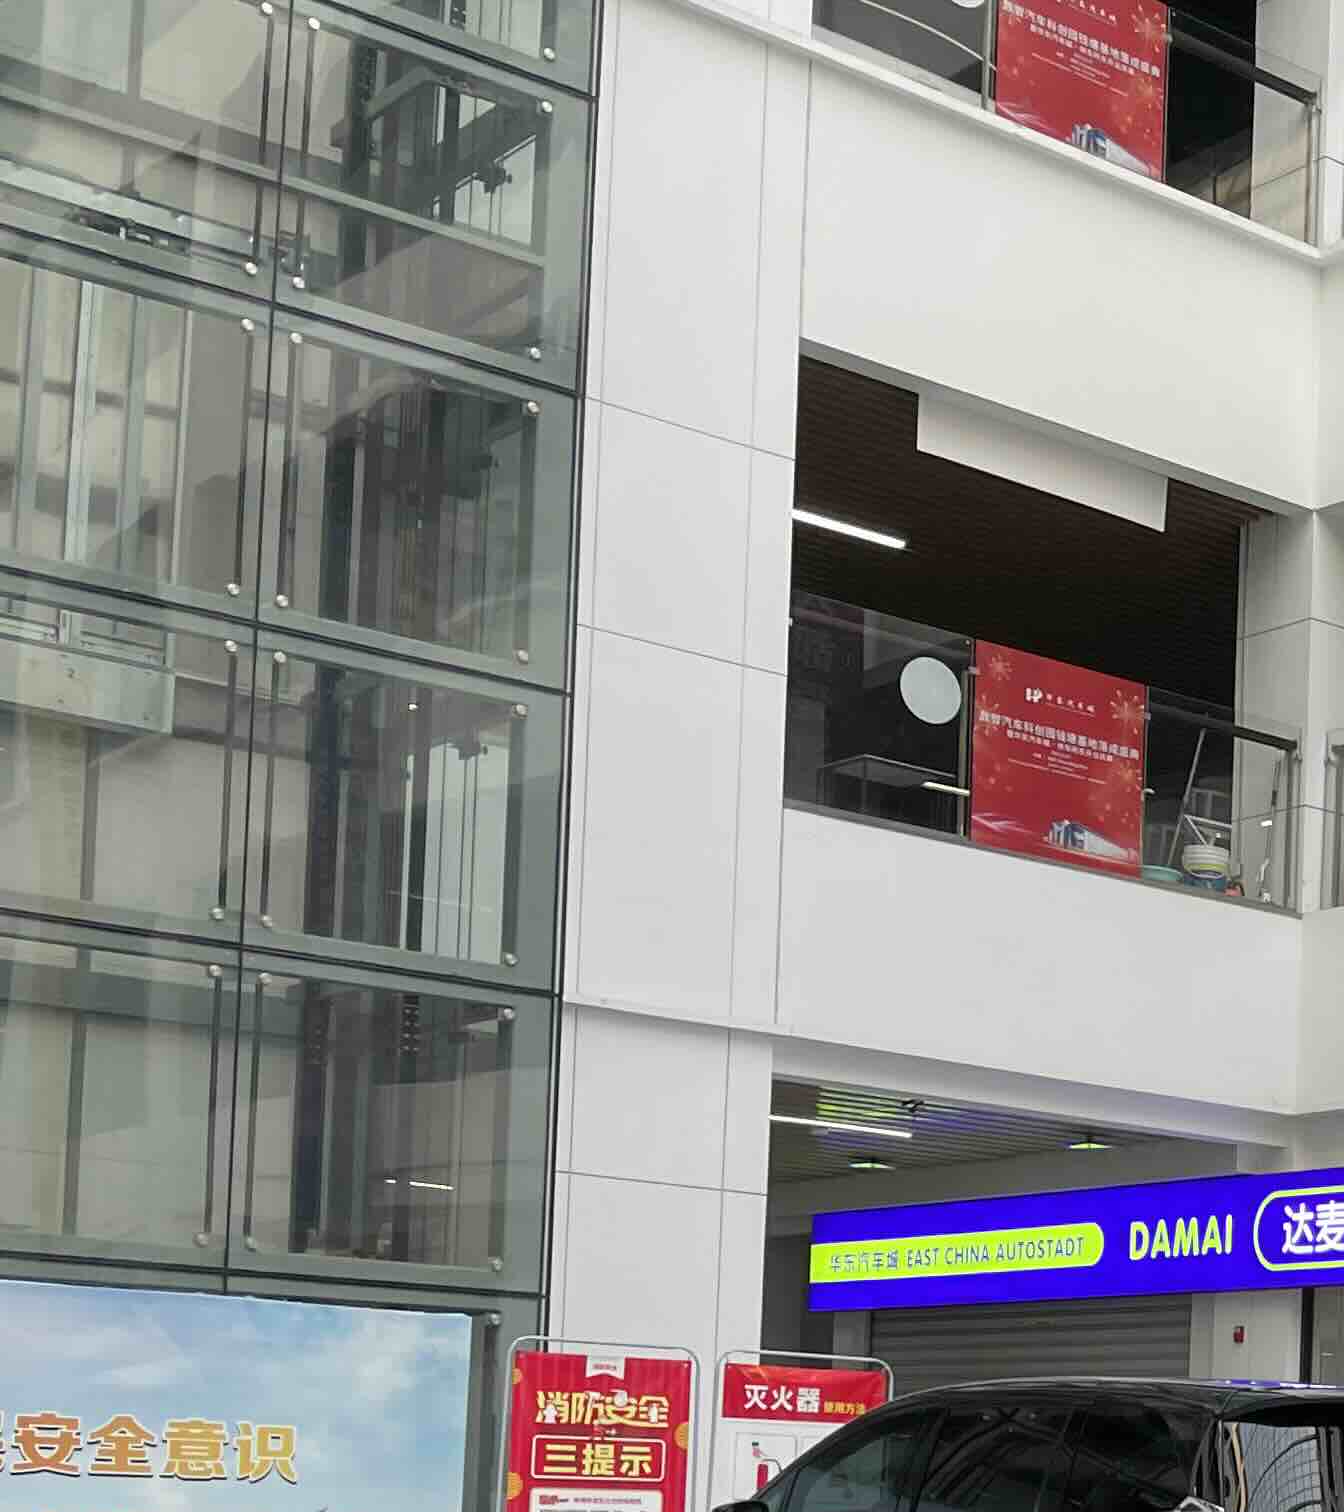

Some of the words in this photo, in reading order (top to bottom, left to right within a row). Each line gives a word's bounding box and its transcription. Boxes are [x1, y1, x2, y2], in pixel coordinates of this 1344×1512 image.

[830, 1251, 899, 1273] 华东汽车城
[906, 1247, 940, 1268] EAST
[944, 1243, 990, 1265] CHINA
[996, 1236, 1085, 1261] AUTOSTADT
[1129, 1213, 1233, 1261] DAMAI
[535, 1389, 670, 1429] 消防安全
[744, 1384, 821, 1414] 灭火器
[0, 1411, 297, 1485] 安全意识
[543, 1443, 652, 1477] 三提示
